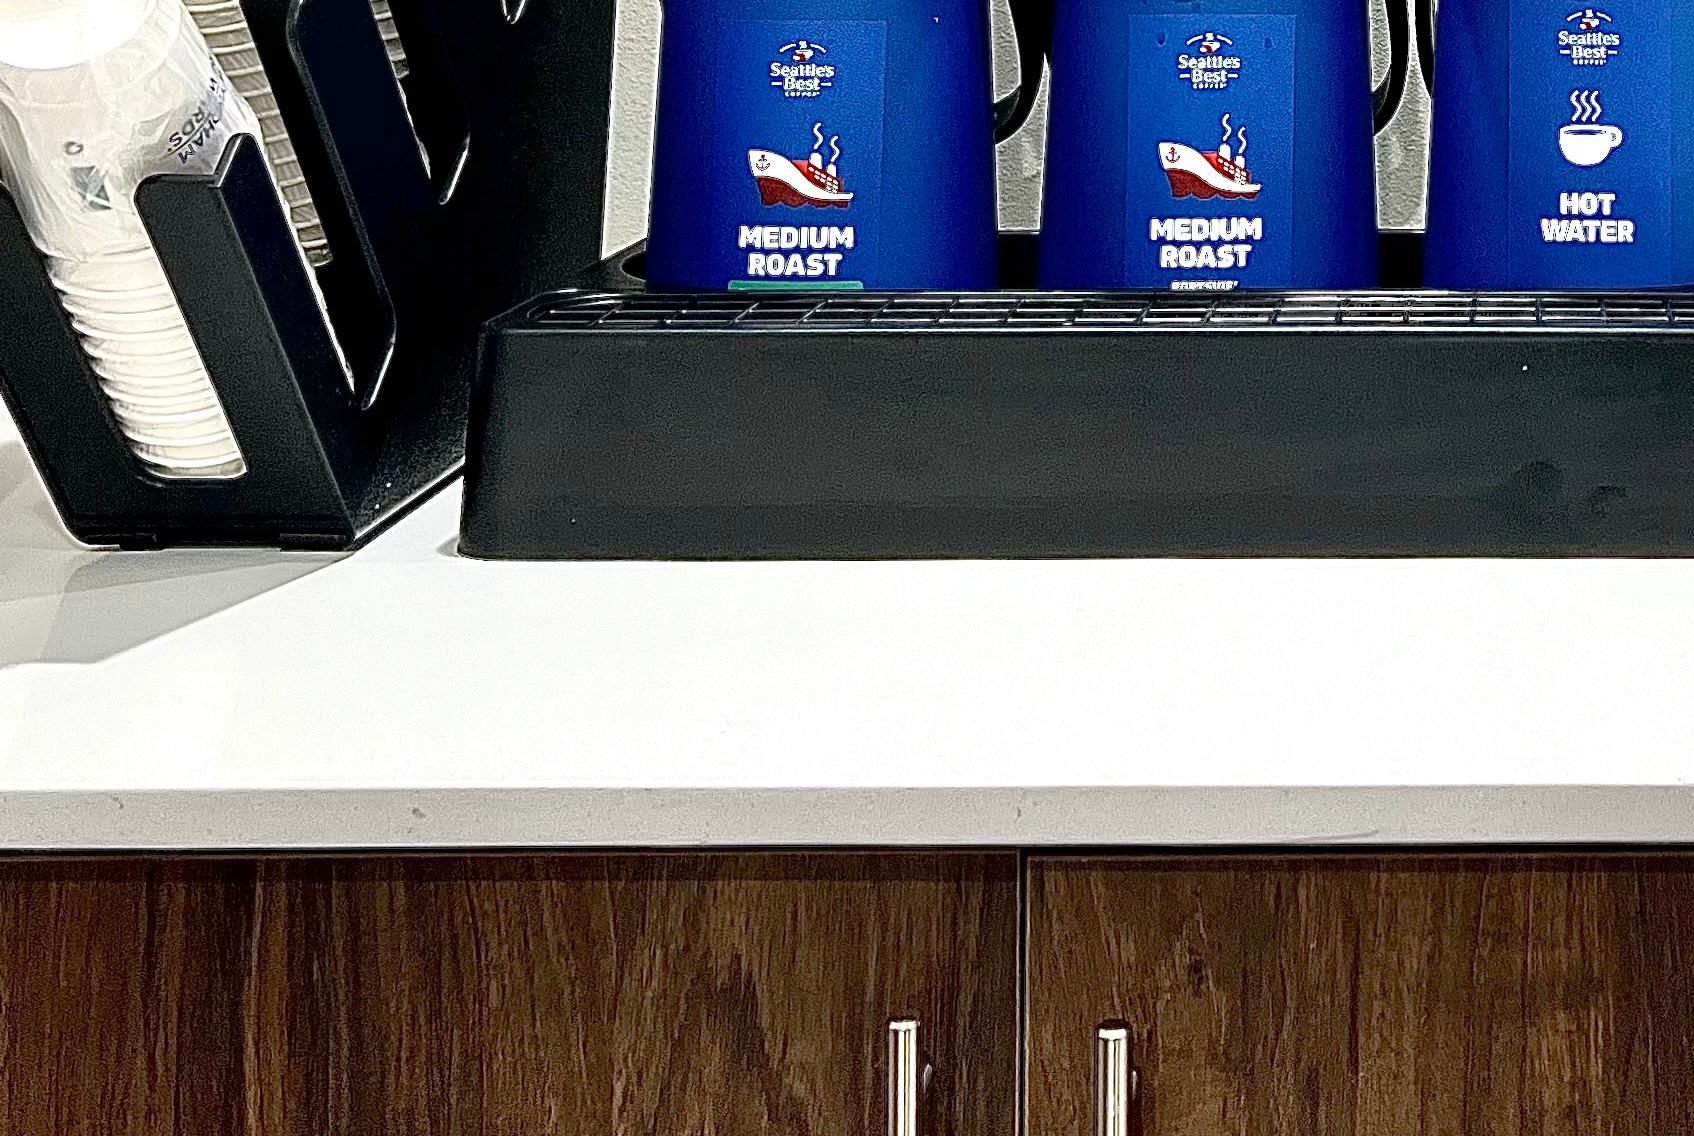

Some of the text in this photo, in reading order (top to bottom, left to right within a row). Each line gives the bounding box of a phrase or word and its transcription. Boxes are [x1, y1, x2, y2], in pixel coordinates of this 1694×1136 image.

[1571, 45, 1607, 59] Best
[783, 77, 821, 91] Best
[1191, 69, 1228, 82] Best
[1559, 191, 1616, 216] HOT
[738, 224, 855, 250] MEDIUM
[1149, 216, 1263, 242] MEDIUM
[1540, 217, 1635, 243] WATER
[747, 252, 843, 277] ROAST
[1160, 244, 1253, 269] ROAST
